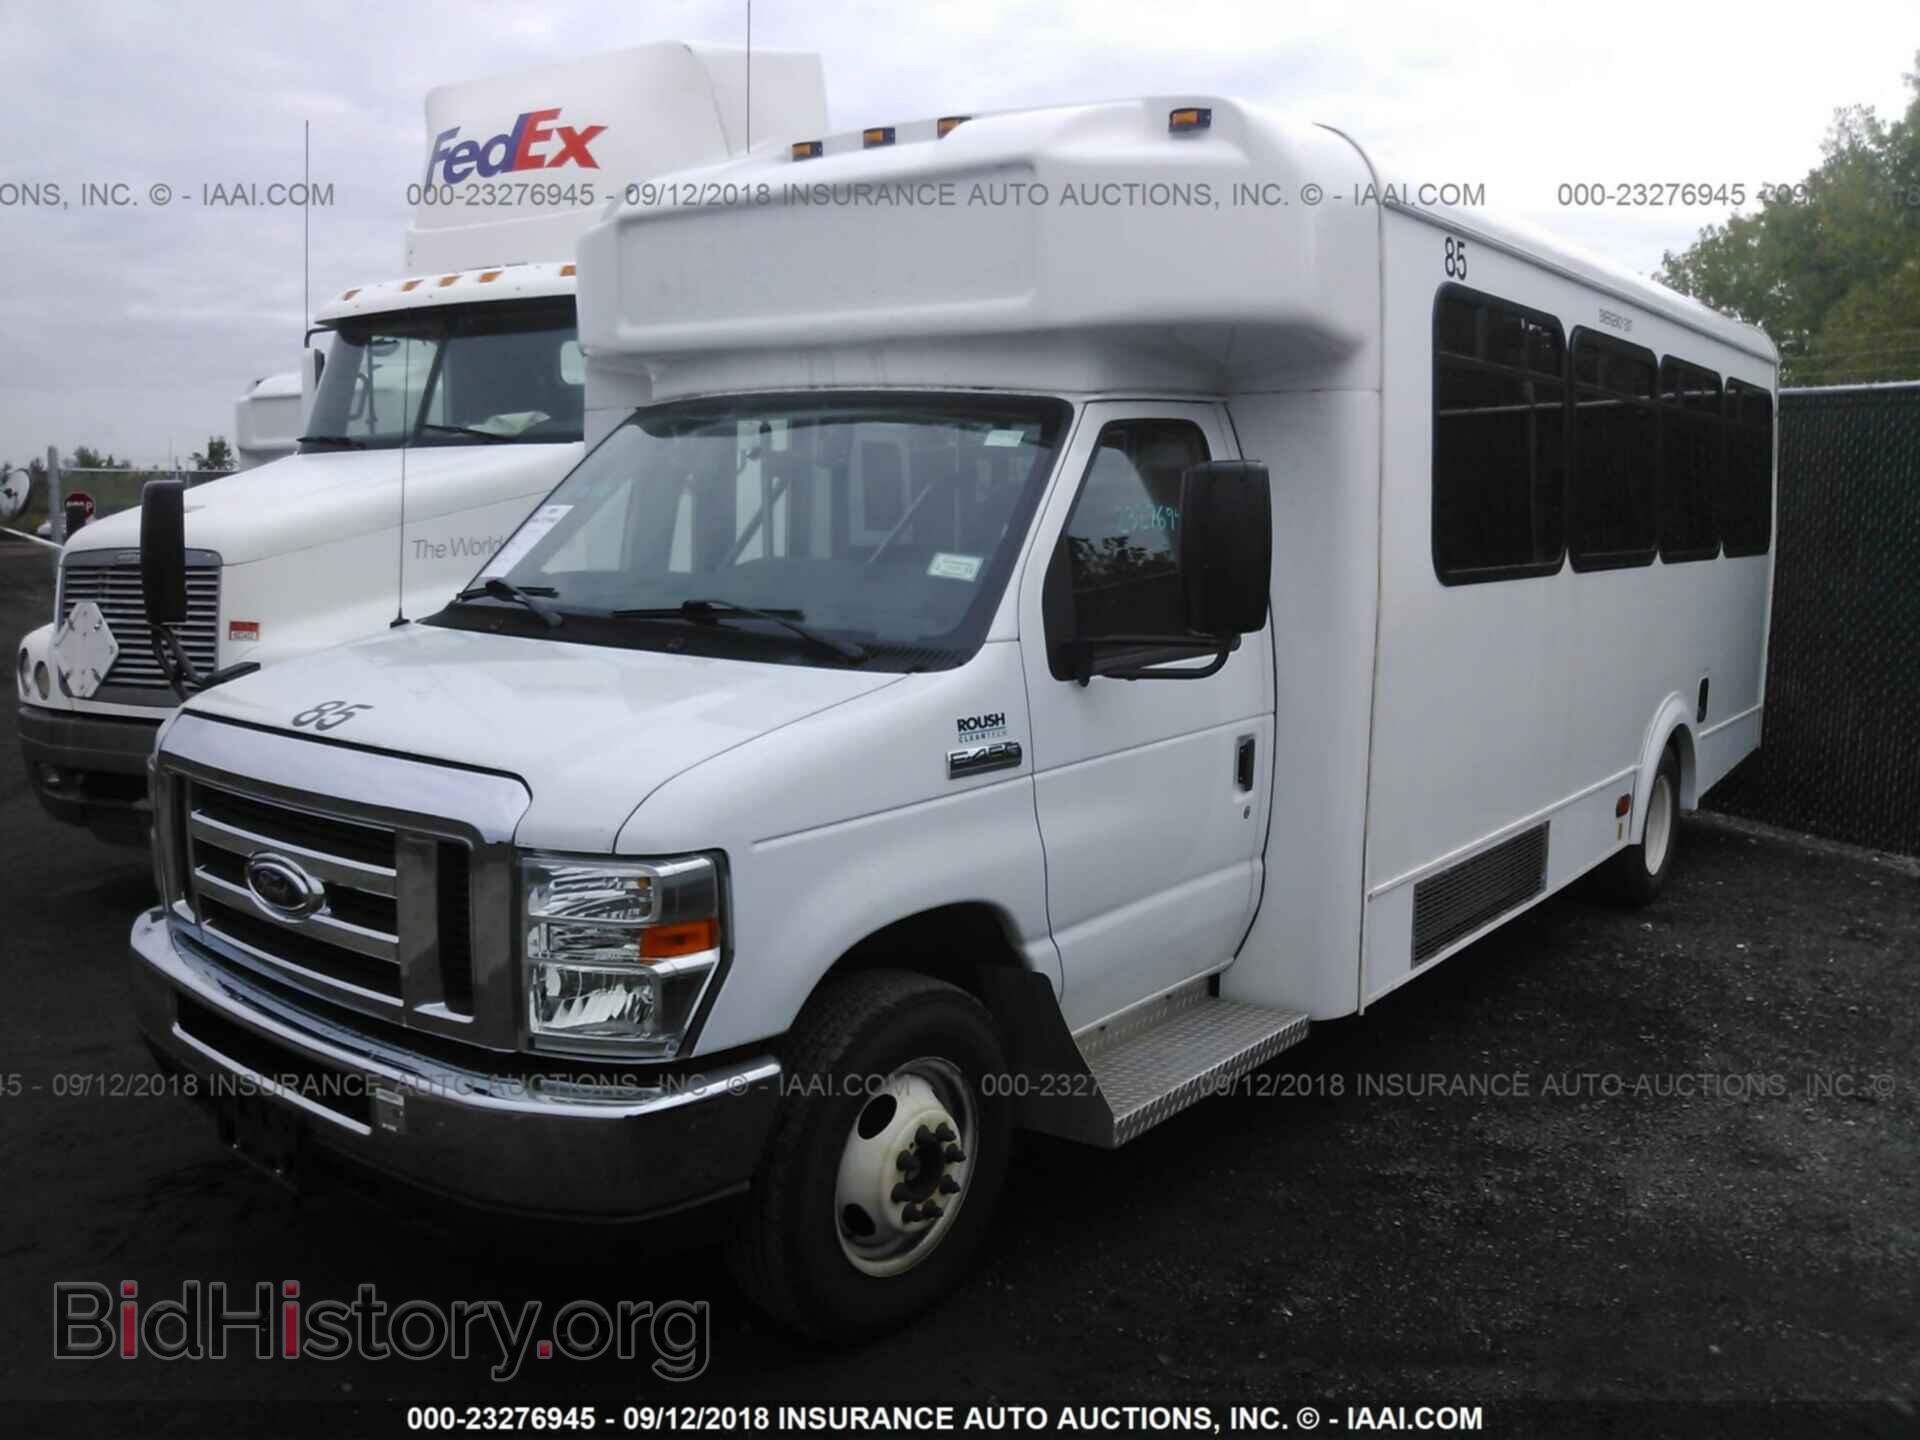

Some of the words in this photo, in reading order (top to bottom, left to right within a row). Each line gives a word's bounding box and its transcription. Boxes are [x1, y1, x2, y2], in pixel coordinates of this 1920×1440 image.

[425, 108, 608, 194] FedEx
[1445, 237, 1467, 281] 85
[412, 536, 447, 559] The
[292, 701, 375, 731] 85
[957, 712, 1006, 732] ROUSH
